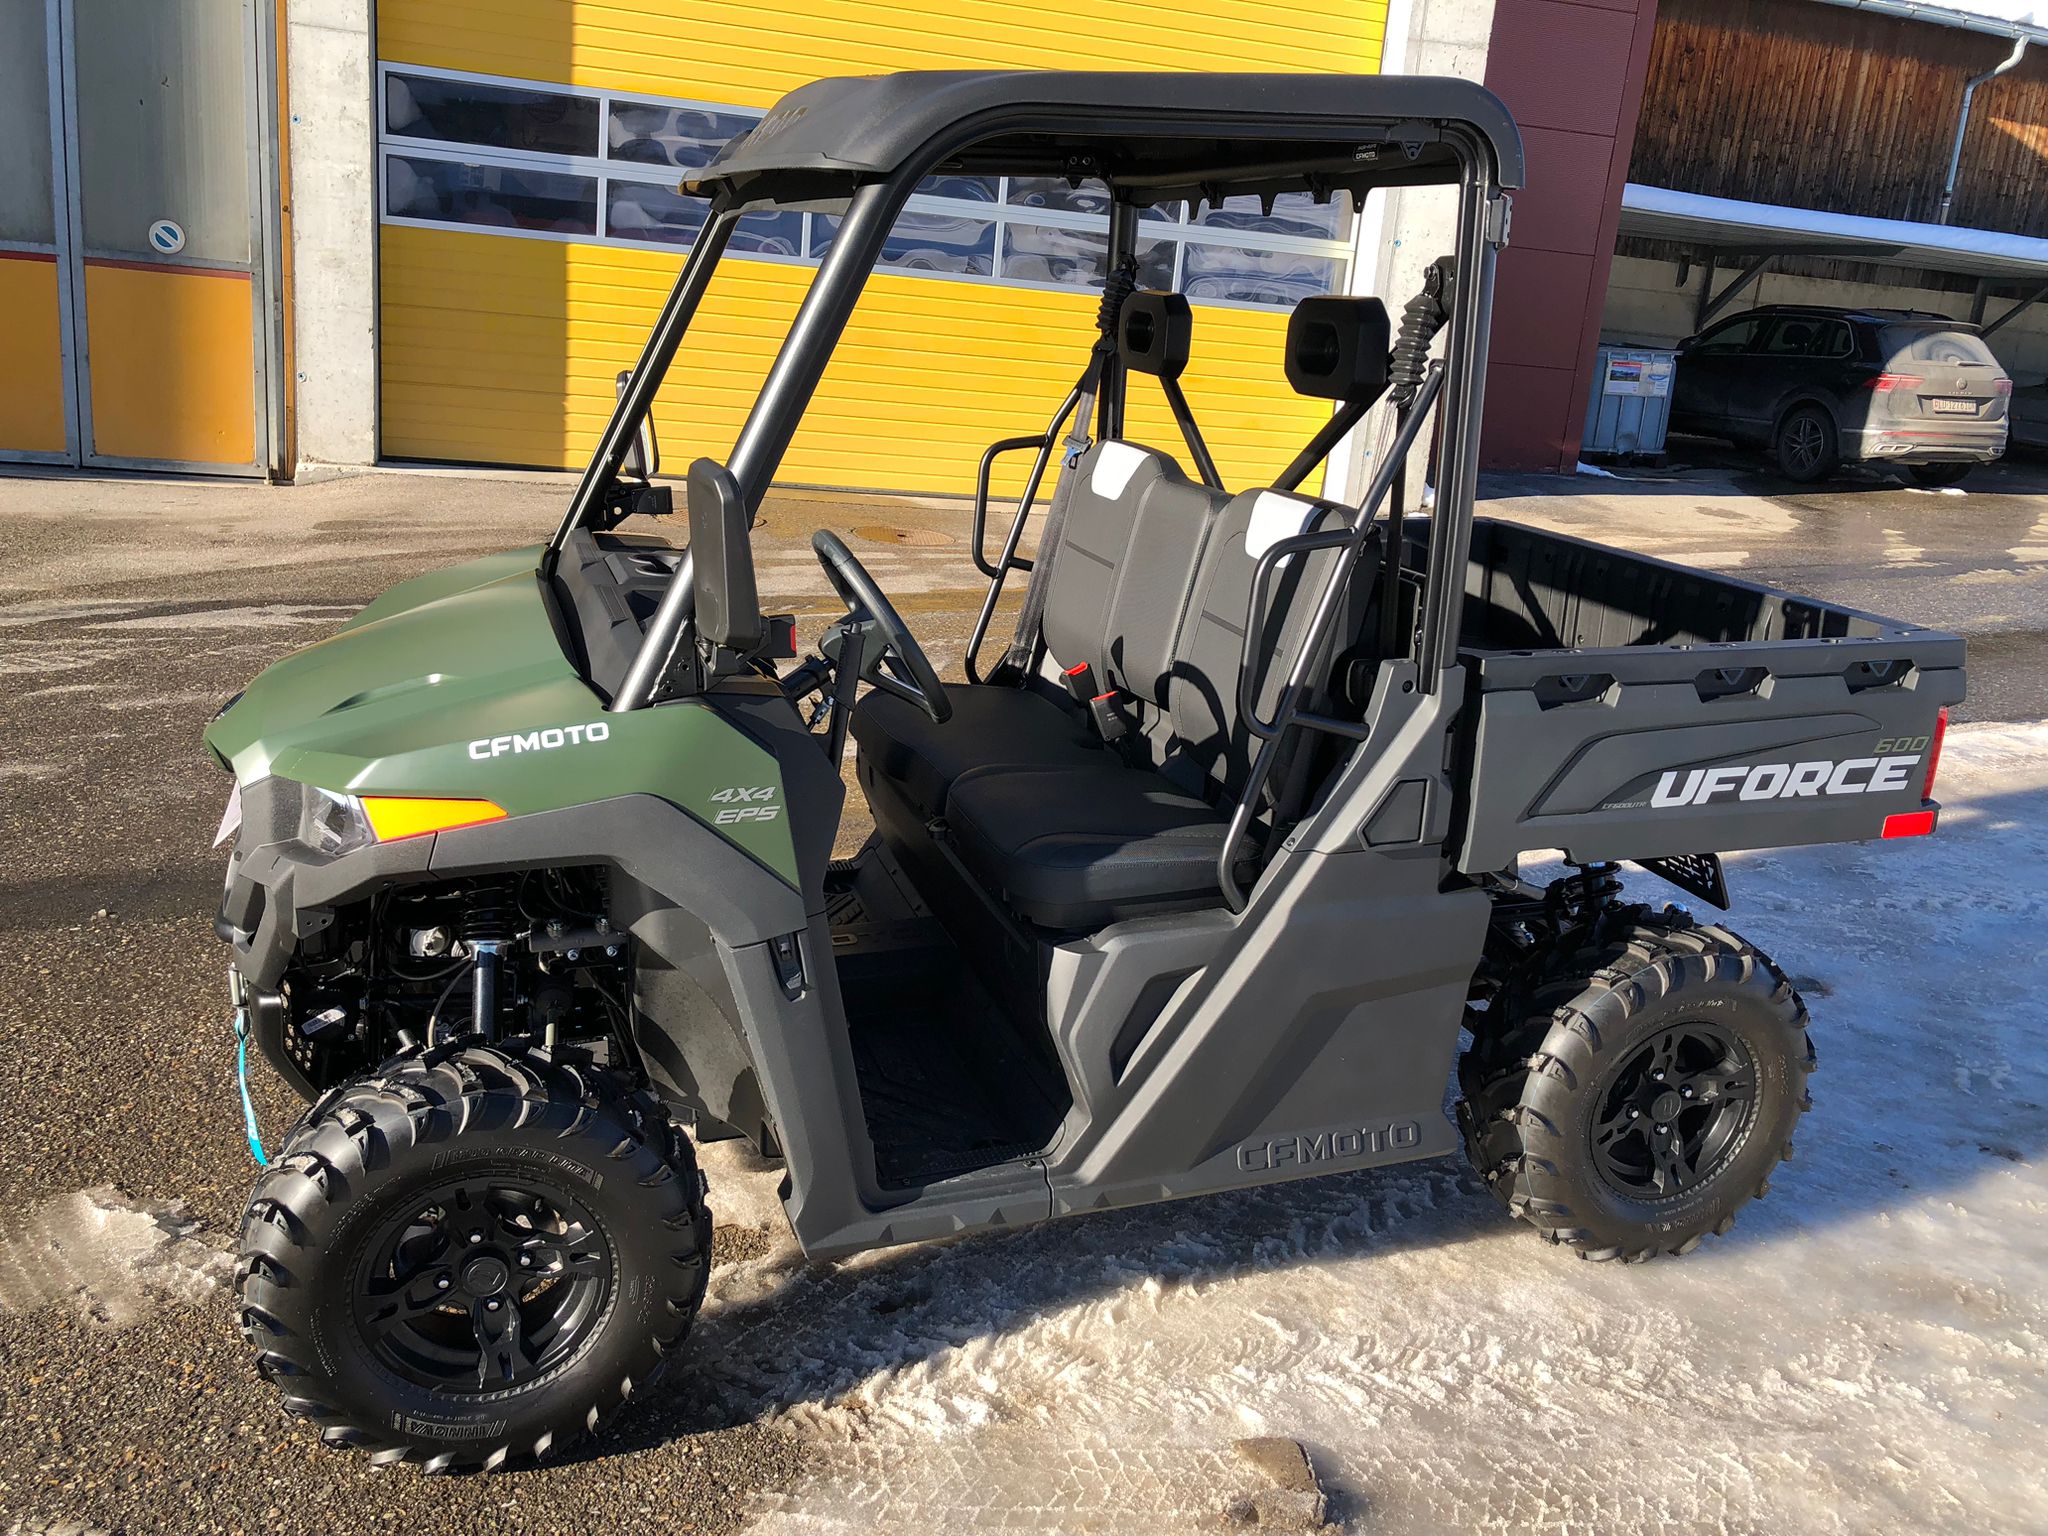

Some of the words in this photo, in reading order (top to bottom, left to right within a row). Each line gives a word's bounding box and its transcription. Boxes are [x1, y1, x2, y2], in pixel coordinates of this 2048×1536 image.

[468, 721, 610, 760] CFMOTO
[1873, 736, 1931, 754] 600
[710, 786, 776, 803] 4X4
[1650, 754, 1922, 809] UFORCE
[714, 805, 781, 824] EPS
[1236, 1119, 1423, 1172] CFMOTO
